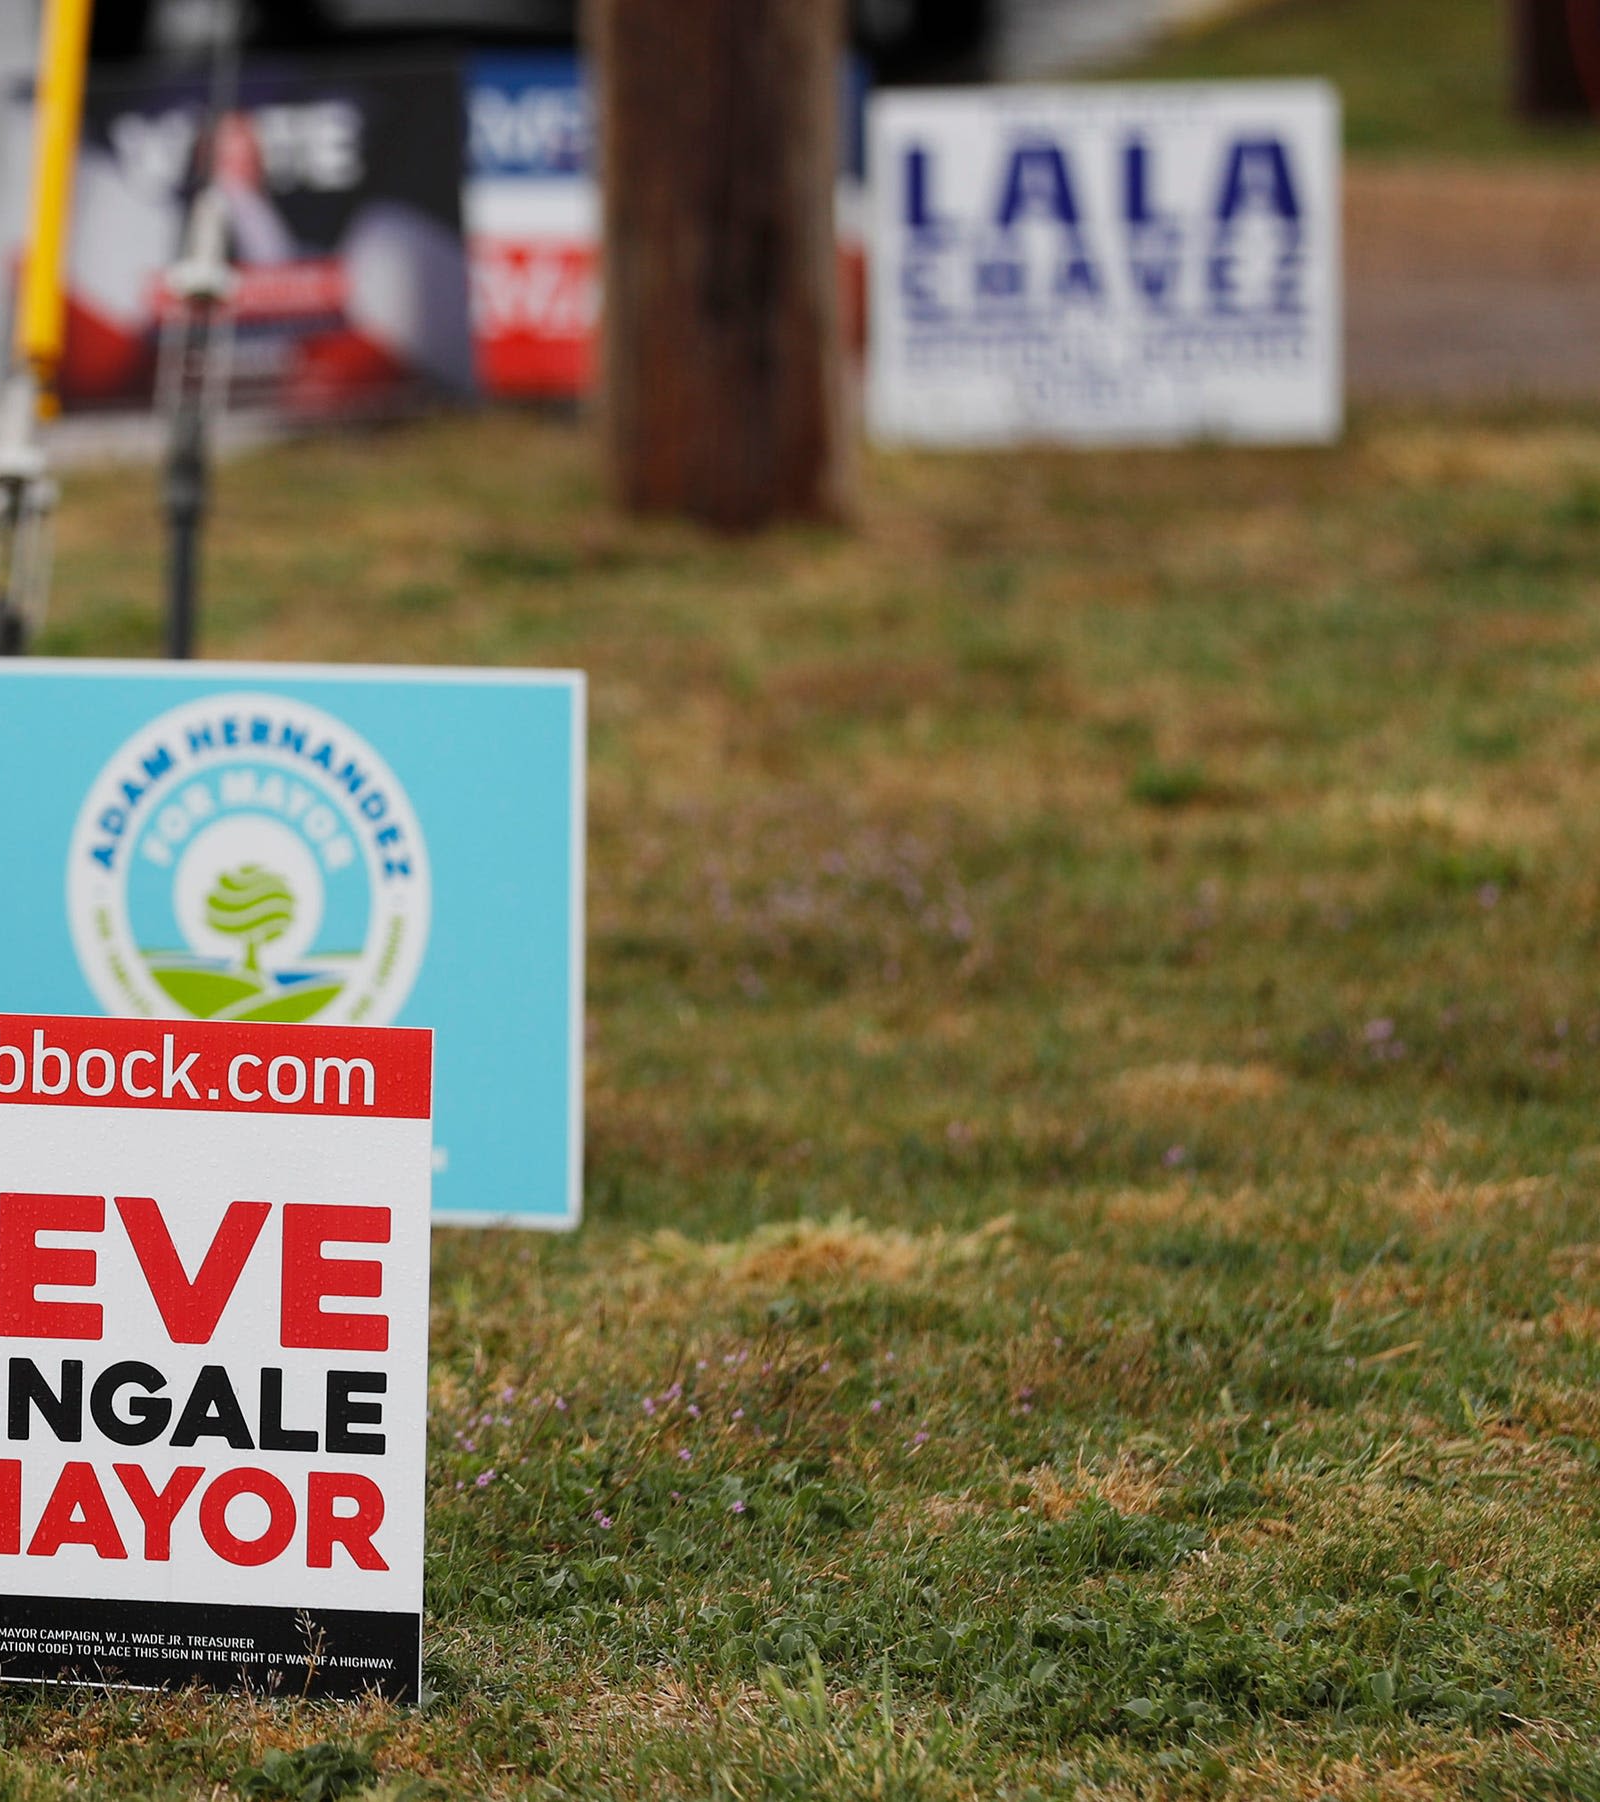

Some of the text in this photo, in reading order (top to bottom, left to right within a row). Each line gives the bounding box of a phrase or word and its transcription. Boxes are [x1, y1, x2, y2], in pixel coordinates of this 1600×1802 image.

[110, 104, 364, 194] VTE
[904, 136, 1300, 244] LALA
[90, 718, 411, 876] ADAM HERNANDEZ
[143, 768, 355, 871] FOR MAYOR
[37, 1642, 73, 1657] CODE)
[76, 1643, 90, 1656] TO
[93, 1644, 131, 1658] PLACE
[133, 1646, 159, 1659] THIS
[161, 1647, 189, 1660] SIGN
[191, 1648, 203, 1661] IN
[206, 1649, 227, 1662] THE
[231, 1650, 265, 1663] RIGHT
[267, 1651, 283, 1664] OF
[313, 1653, 327, 1666] OF
[329, 1654, 337, 1666] A
[340, 1654, 396, 1669] HIGHWAY.
[40, 1628, 102, 1644] CAMPAIGN,
[105, 1631, 128, 1644] W.J.
[131, 1632, 165, 1645] WADE
[167, 1634, 184, 1646] JR.
[187, 1634, 254, 1649] TREASURER
